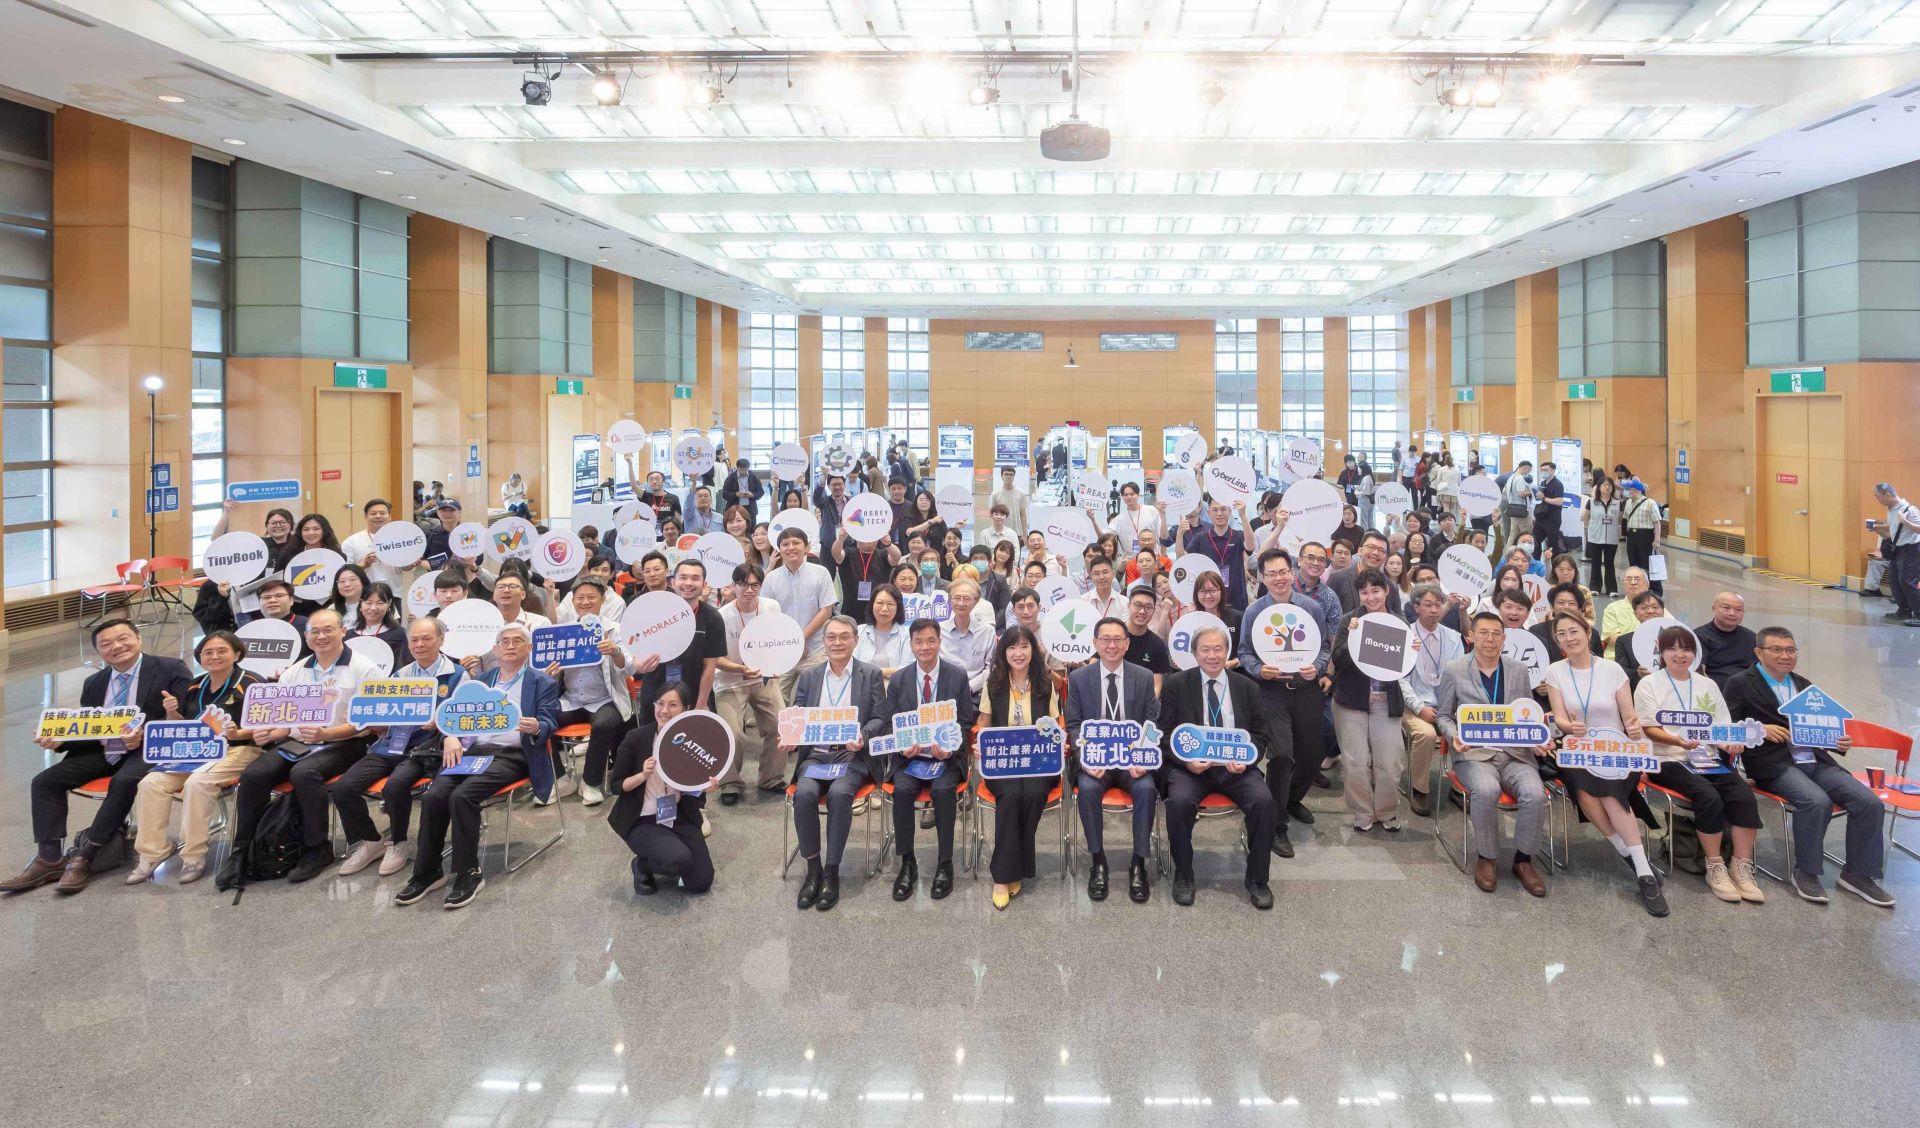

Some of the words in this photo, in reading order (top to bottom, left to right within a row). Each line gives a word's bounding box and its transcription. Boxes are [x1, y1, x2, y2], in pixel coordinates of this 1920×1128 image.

[1291, 448, 1318, 463] IOT.AI
[1211, 468, 1248, 491] CyberLink
[1087, 488, 1106, 499] REAS
[1459, 490, 1498, 501] DeepMentor
[207, 549, 264, 567] TinyBook
[643, 615, 680, 638] MORALE
[680, 610, 690, 619] AI
[248, 642, 289, 653] ELLIS
[536, 636, 599, 651] 新北產業AI化
[758, 638, 800, 649] LaplaceAI
[1051, 643, 1091, 654] KDAN
[250, 685, 322, 699] 推動AI轉型
[364, 685, 411, 696] 補助支持
[445, 702, 495, 712] AI驅動企業
[459, 714, 509, 731] 新未來
[1467, 711, 1507, 723] AI轉型
[1661, 713, 1711, 726] 新北助攻
[41, 722, 115, 737] 加速AI導入
[150, 726, 212, 739] AI賦能產業
[804, 724, 858, 742] 拼經濟
[1085, 725, 1139, 739] 產業AI化
[1795, 728, 1841, 744] 再升級
[683, 737, 718, 766] ATTRAK
[985, 742, 1057, 757] 新北產業AI化
[1206, 745, 1248, 760] AI應用
[1566, 739, 1650, 754] 多元解決方案
[985, 757, 1031, 769] 輔導計畫
[1559, 753, 1659, 770] 提升生產競爭力
